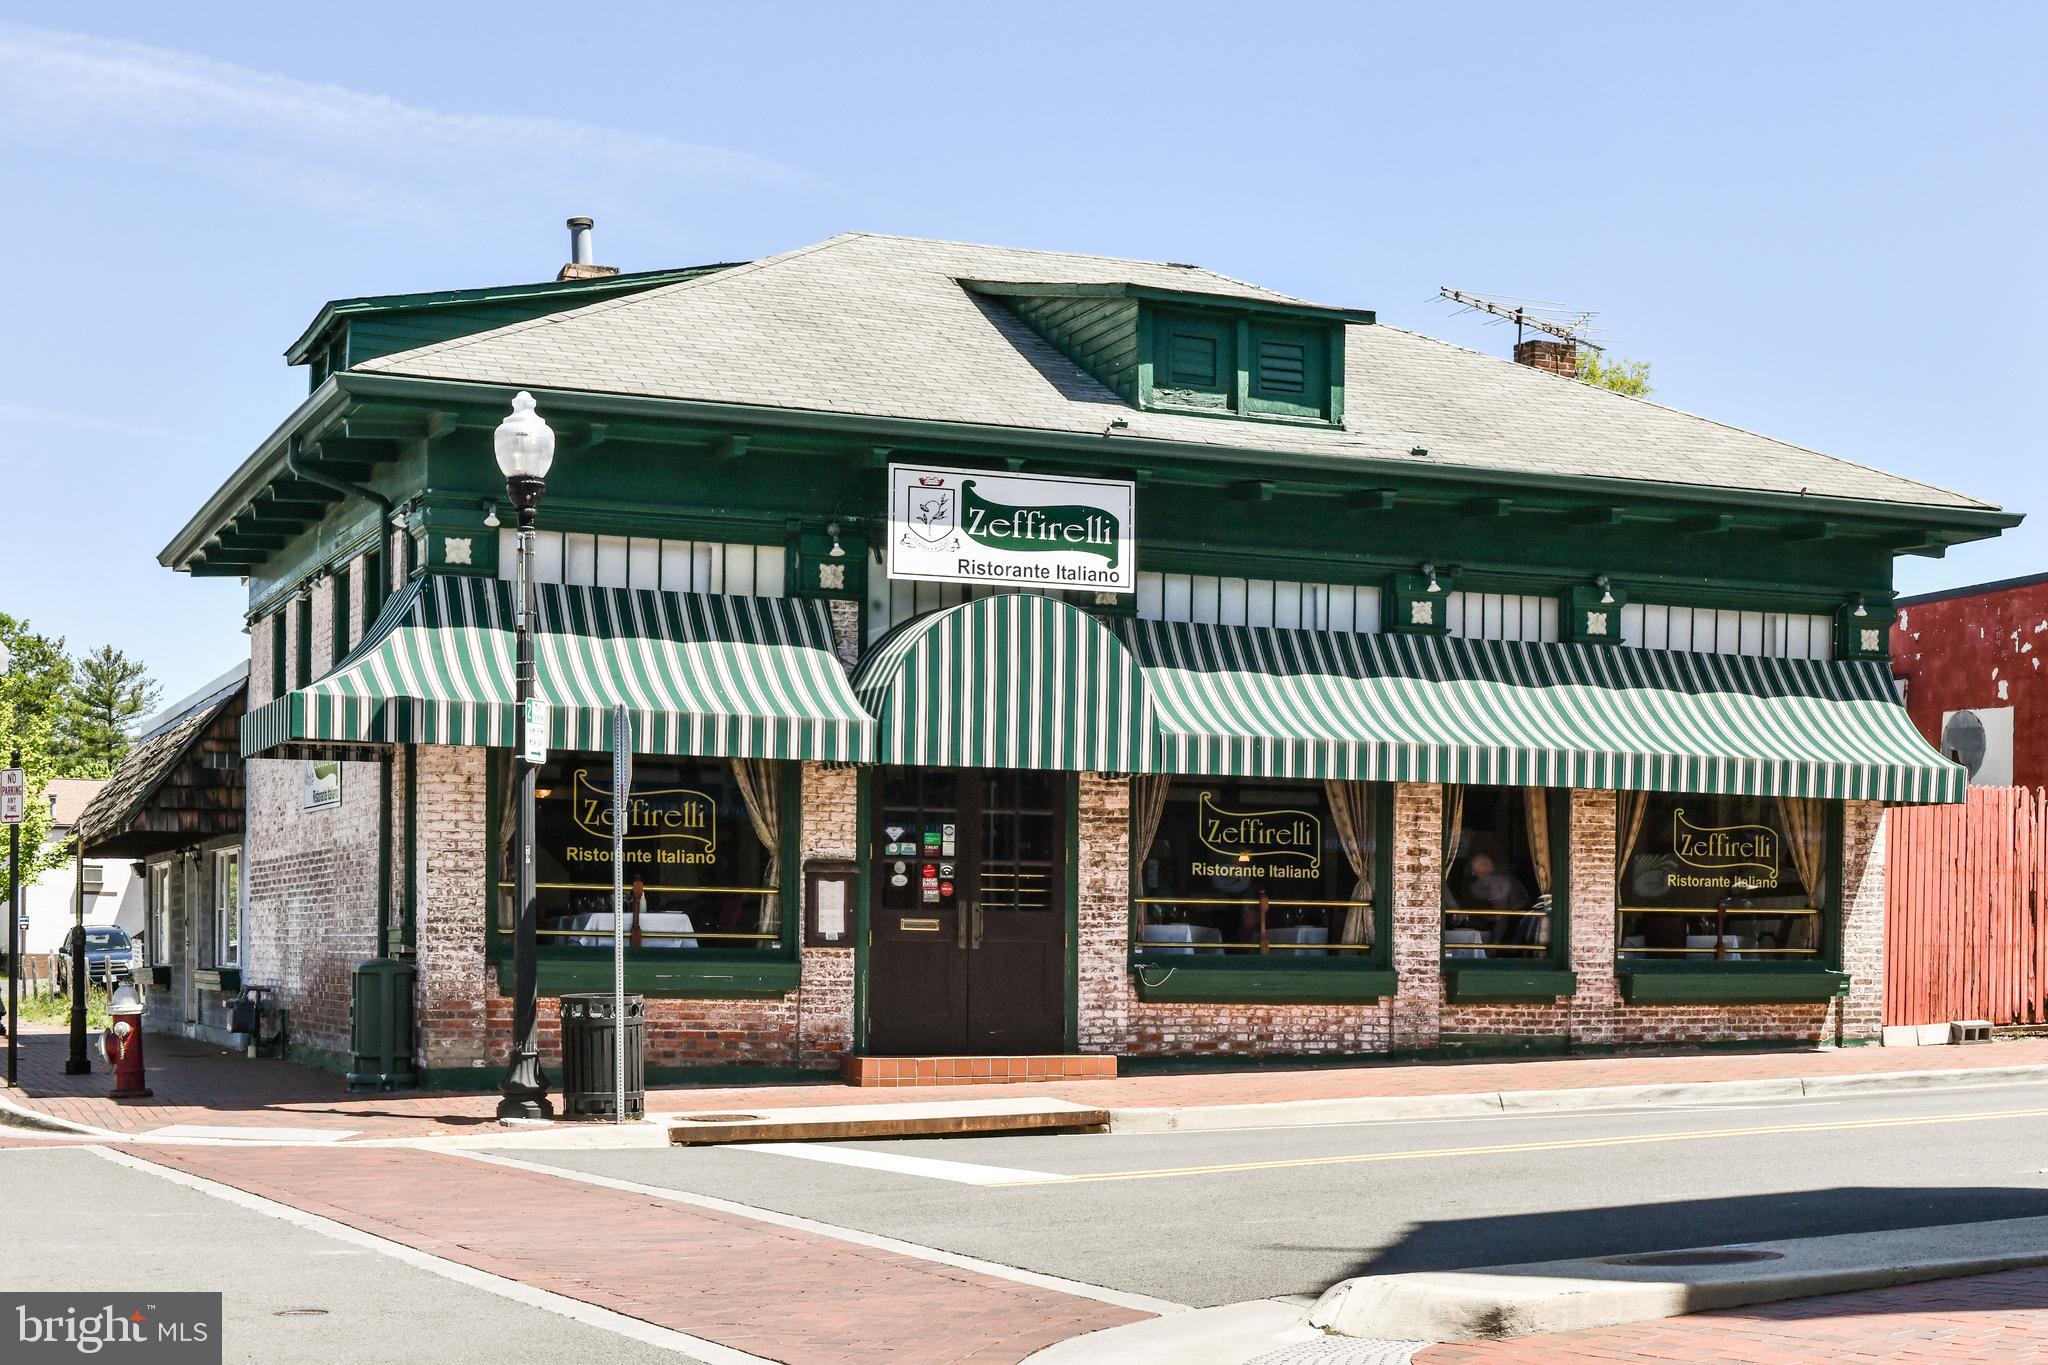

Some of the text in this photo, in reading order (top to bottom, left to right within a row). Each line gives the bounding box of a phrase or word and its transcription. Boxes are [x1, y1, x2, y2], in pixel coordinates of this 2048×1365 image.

[969, 507, 1112, 544] Zeffirelli
[958, 558, 1120, 583] Ristorante Italiano
[7, 773, 16, 783] NO
[2, 786, 22, 795] PARKING
[6, 804, 17, 812] TIME
[584, 798, 705, 828] Zefirelli
[1207, 818, 1312, 846] Zeffirelli
[1680, 833, 1771, 858] Zeffirelli
[657, 849, 716, 865] Italiano
[1191, 862, 1320, 879] Ristorante Italiano
[1667, 874, 1778, 889] Ristorante Italiano
